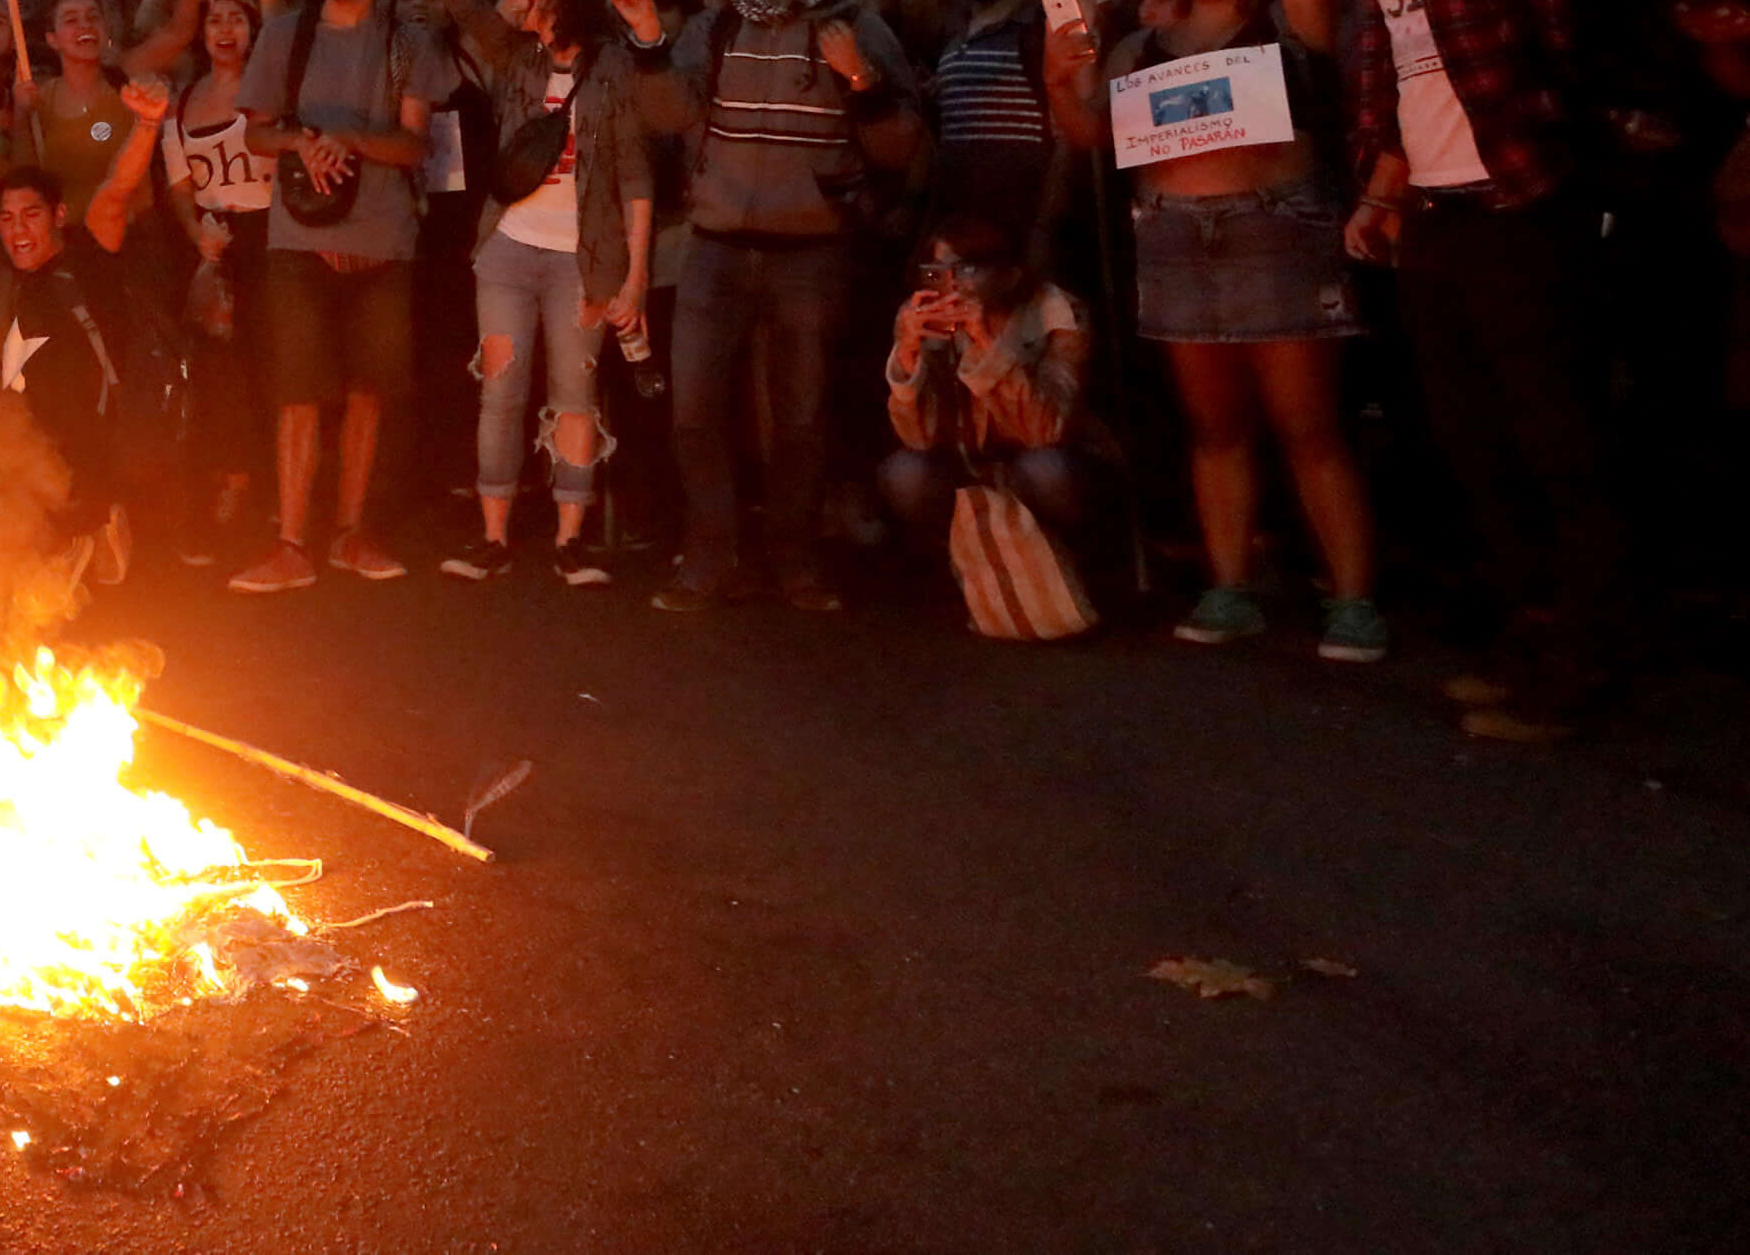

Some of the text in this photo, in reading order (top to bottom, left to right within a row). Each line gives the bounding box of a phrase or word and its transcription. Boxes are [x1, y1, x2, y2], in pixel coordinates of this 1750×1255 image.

[1148, 60, 1210, 83] AVANCES
[1226, 56, 1251, 67] DEL
[1126, 117, 1233, 150] IMPERIALISMO
[1150, 145, 1171, 157] NO
